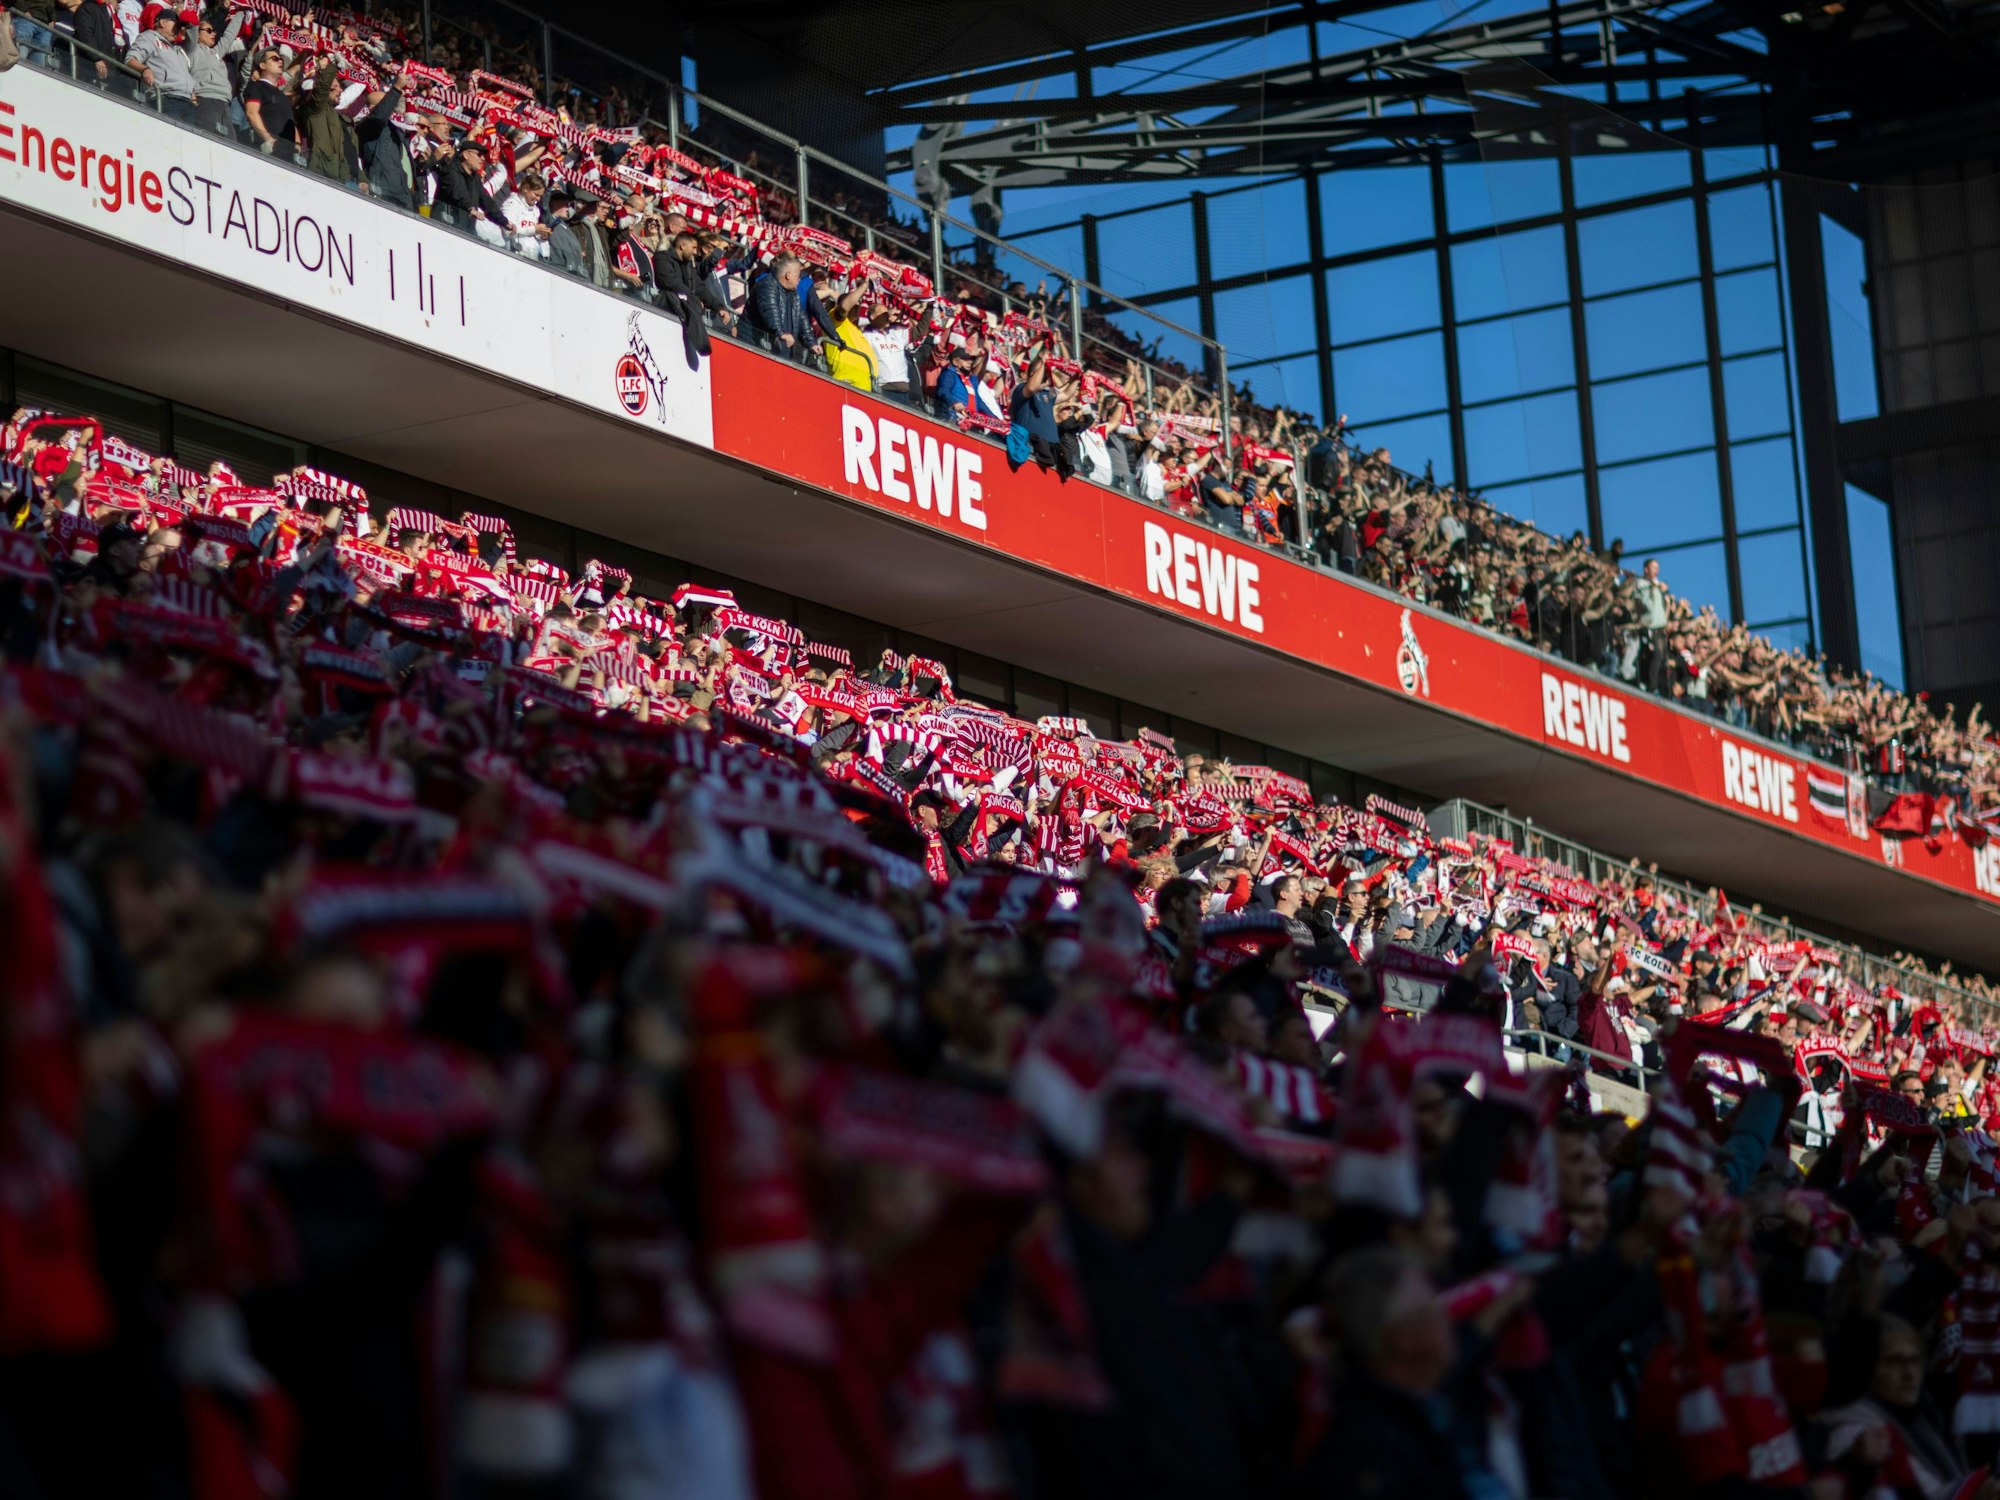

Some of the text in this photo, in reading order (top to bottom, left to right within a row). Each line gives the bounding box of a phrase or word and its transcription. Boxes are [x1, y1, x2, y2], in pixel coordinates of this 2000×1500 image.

[842, 405, 986, 530] REWE
[434, 553, 469, 574] FC KÖLN
[1144, 522, 1263, 632] REWE
[752, 617, 781, 638] KÖLN
[832, 690, 857, 709] KÖLN
[876, 692, 895, 705] KÖLN
[1542, 673, 1630, 762] REWE
[1058, 742, 1076, 758] KÖLN
[1723, 740, 1798, 822] REWE
[1503, 936, 1514, 948] FC
[1630, 946, 1641, 960] FC
[1643, 953, 1673, 975] KÖLN
